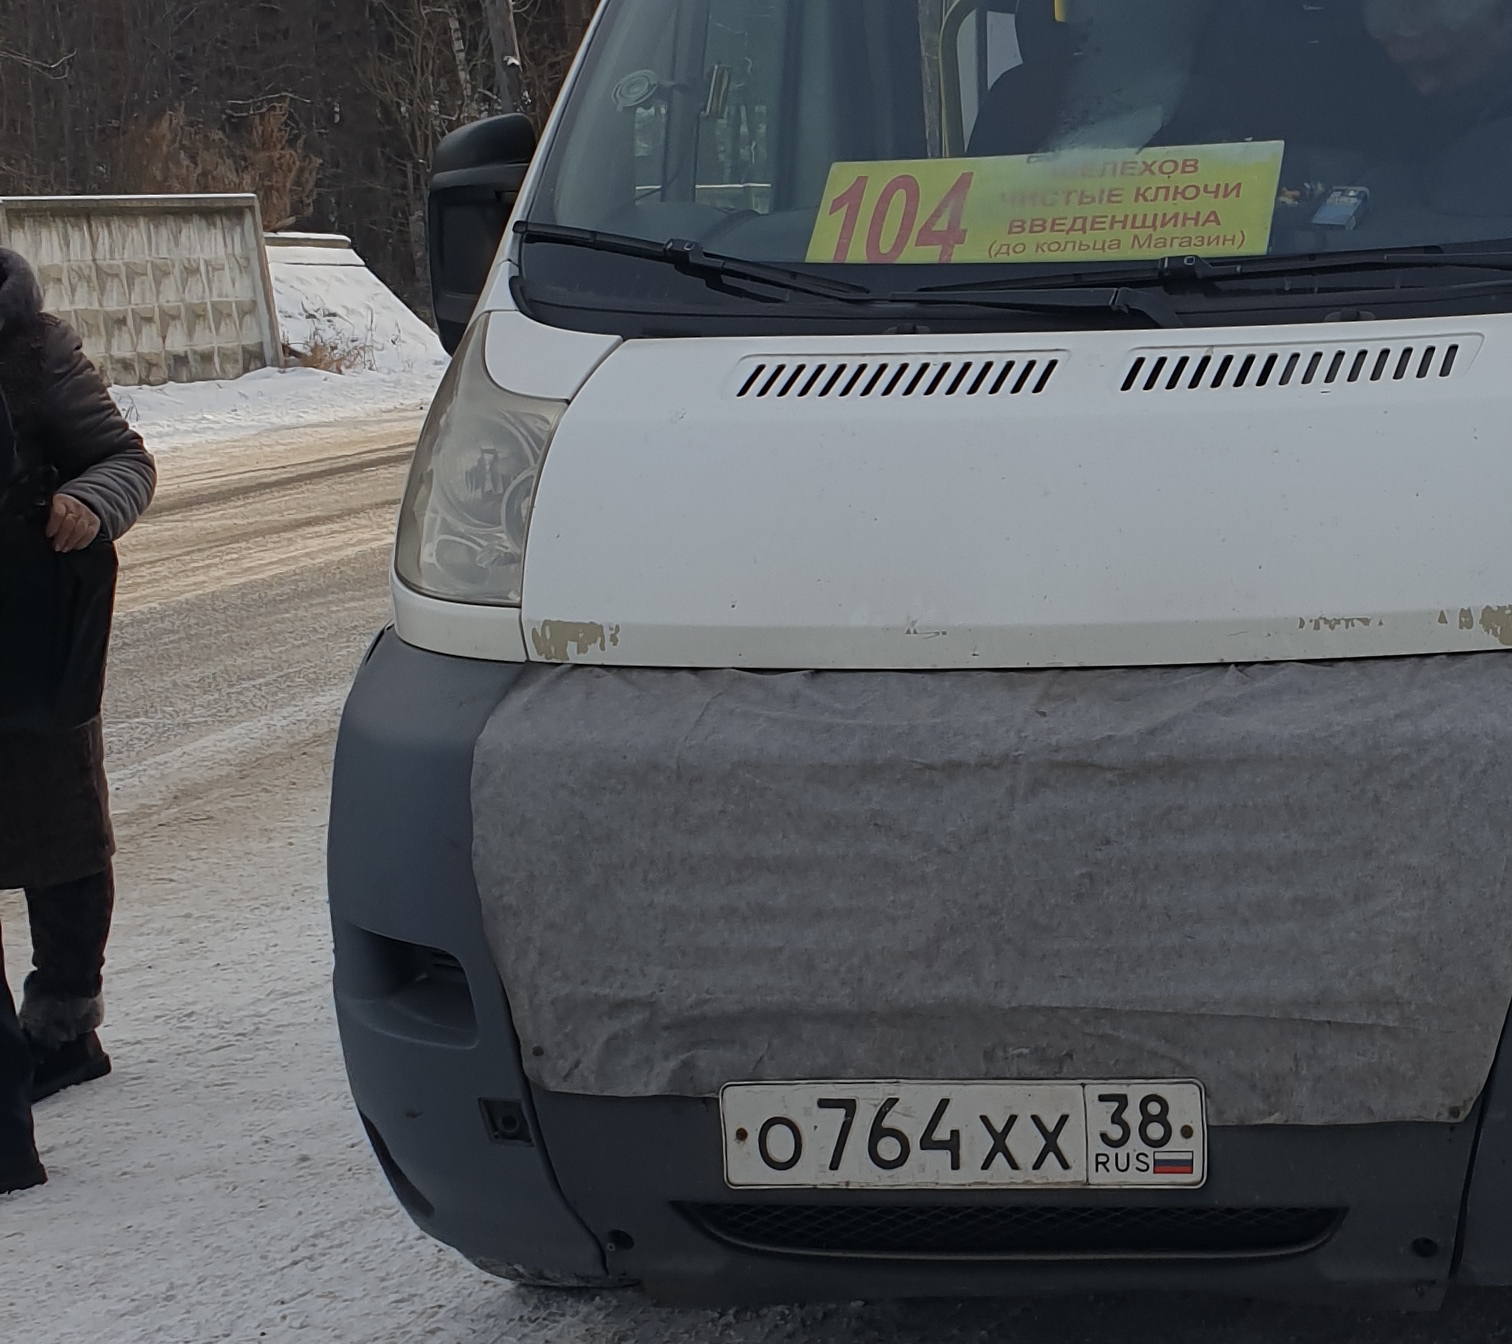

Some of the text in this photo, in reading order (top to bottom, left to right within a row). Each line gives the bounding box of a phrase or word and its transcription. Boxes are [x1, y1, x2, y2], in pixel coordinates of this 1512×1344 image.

[1054, 158, 1200, 180] ЕЛЕХОВ
[1133, 182, 1242, 204] КЛЮЧИ
[828, 171, 974, 264] 104
[1007, 210, 1222, 235] ВВЕДЕНЩИНА
[987, 229, 1246, 258] (до кольца Магазин)
[1097, 1093, 1173, 1149] 38
[1095, 1152, 1151, 1173] RUS
